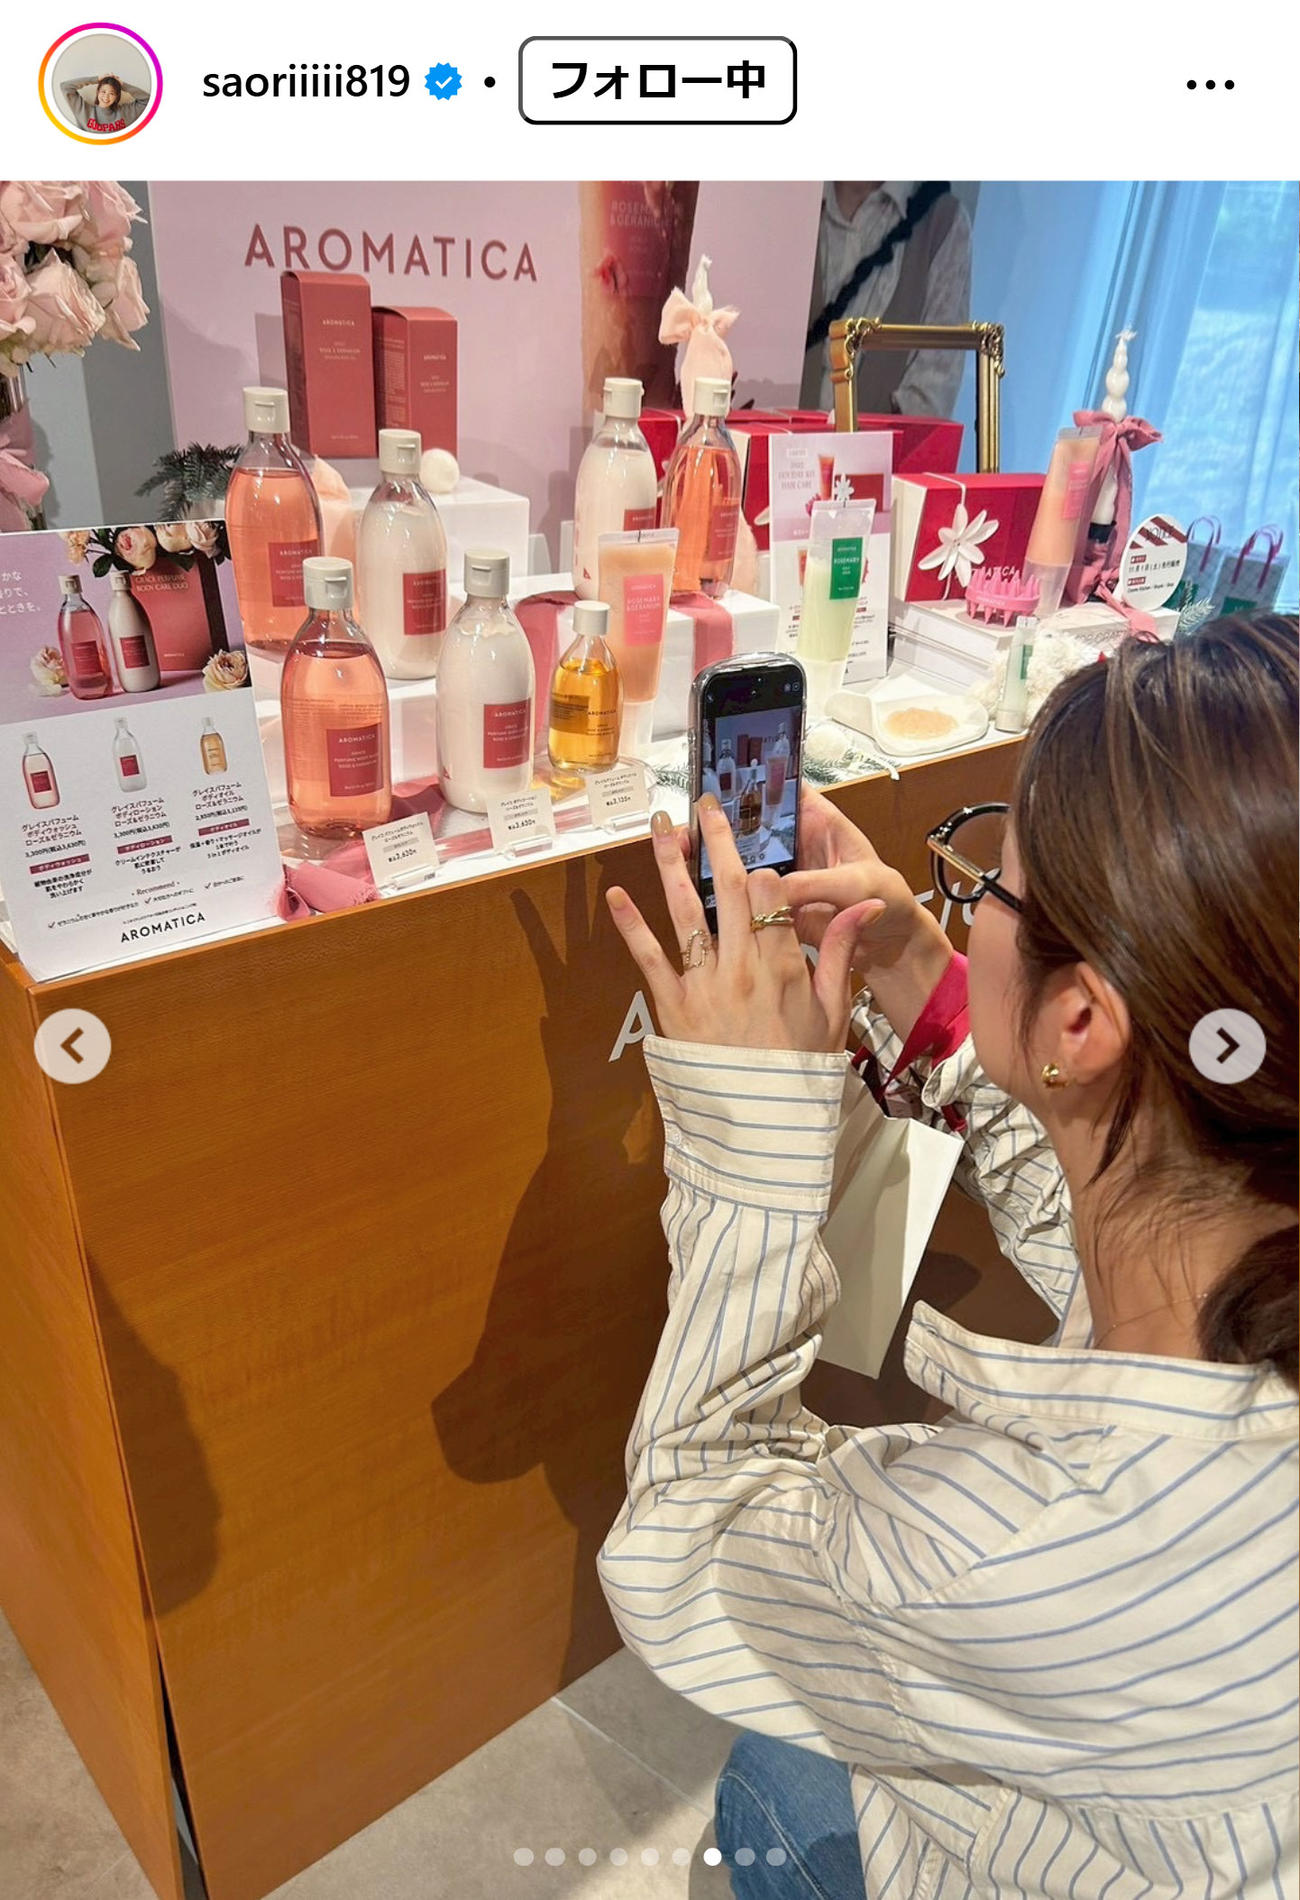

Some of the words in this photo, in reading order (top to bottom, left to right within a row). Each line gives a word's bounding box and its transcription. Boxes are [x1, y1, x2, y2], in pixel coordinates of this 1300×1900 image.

[244, 223, 538, 282] AROMATICA
[0, 587, 29, 599] りで、
[338, 733, 376, 744] AROMATICA
[192, 781, 242, 797] グレイスパフューム
[111, 797, 165, 813] グレイスパフューム
[22, 814, 80, 832] グレイスパフューム
[120, 911, 207, 944] AROMATICA
